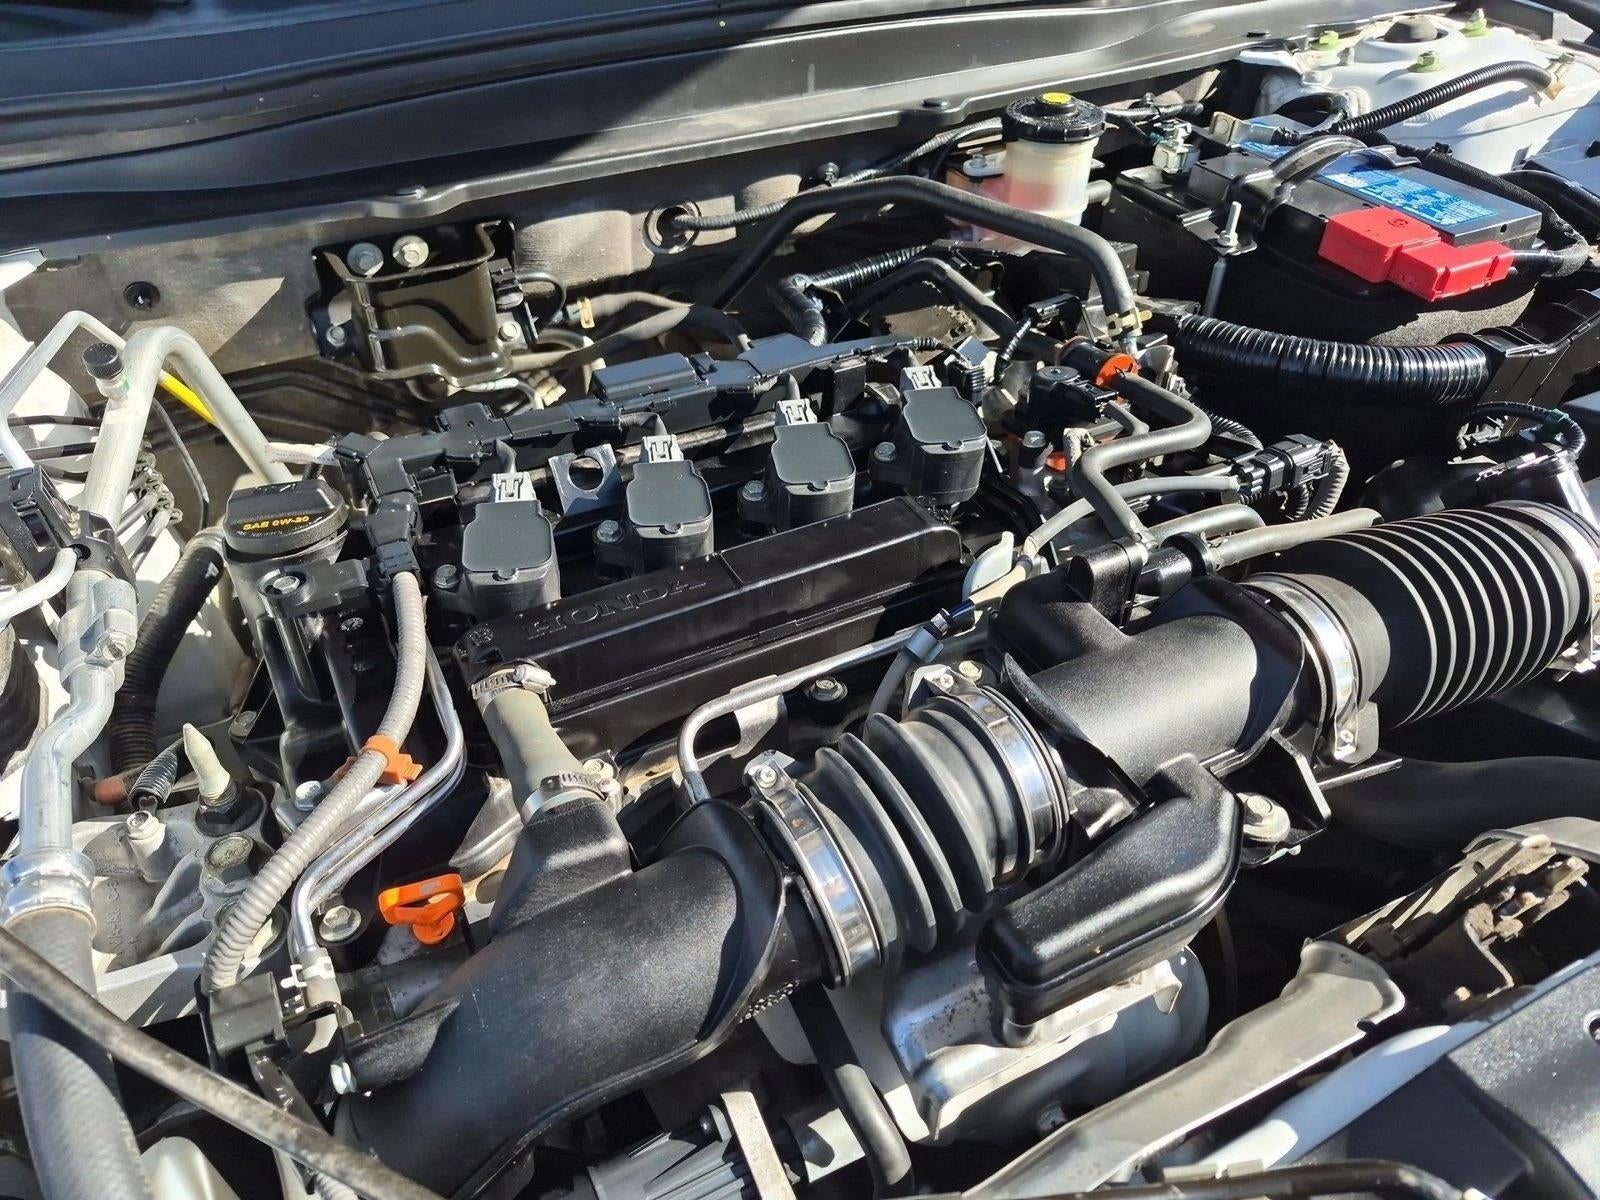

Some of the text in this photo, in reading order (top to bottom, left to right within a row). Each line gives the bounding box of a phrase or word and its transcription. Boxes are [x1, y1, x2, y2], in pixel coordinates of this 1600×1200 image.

[243, 516, 310, 531] SAE 0W-20
[524, 580, 707, 641] HONDA
